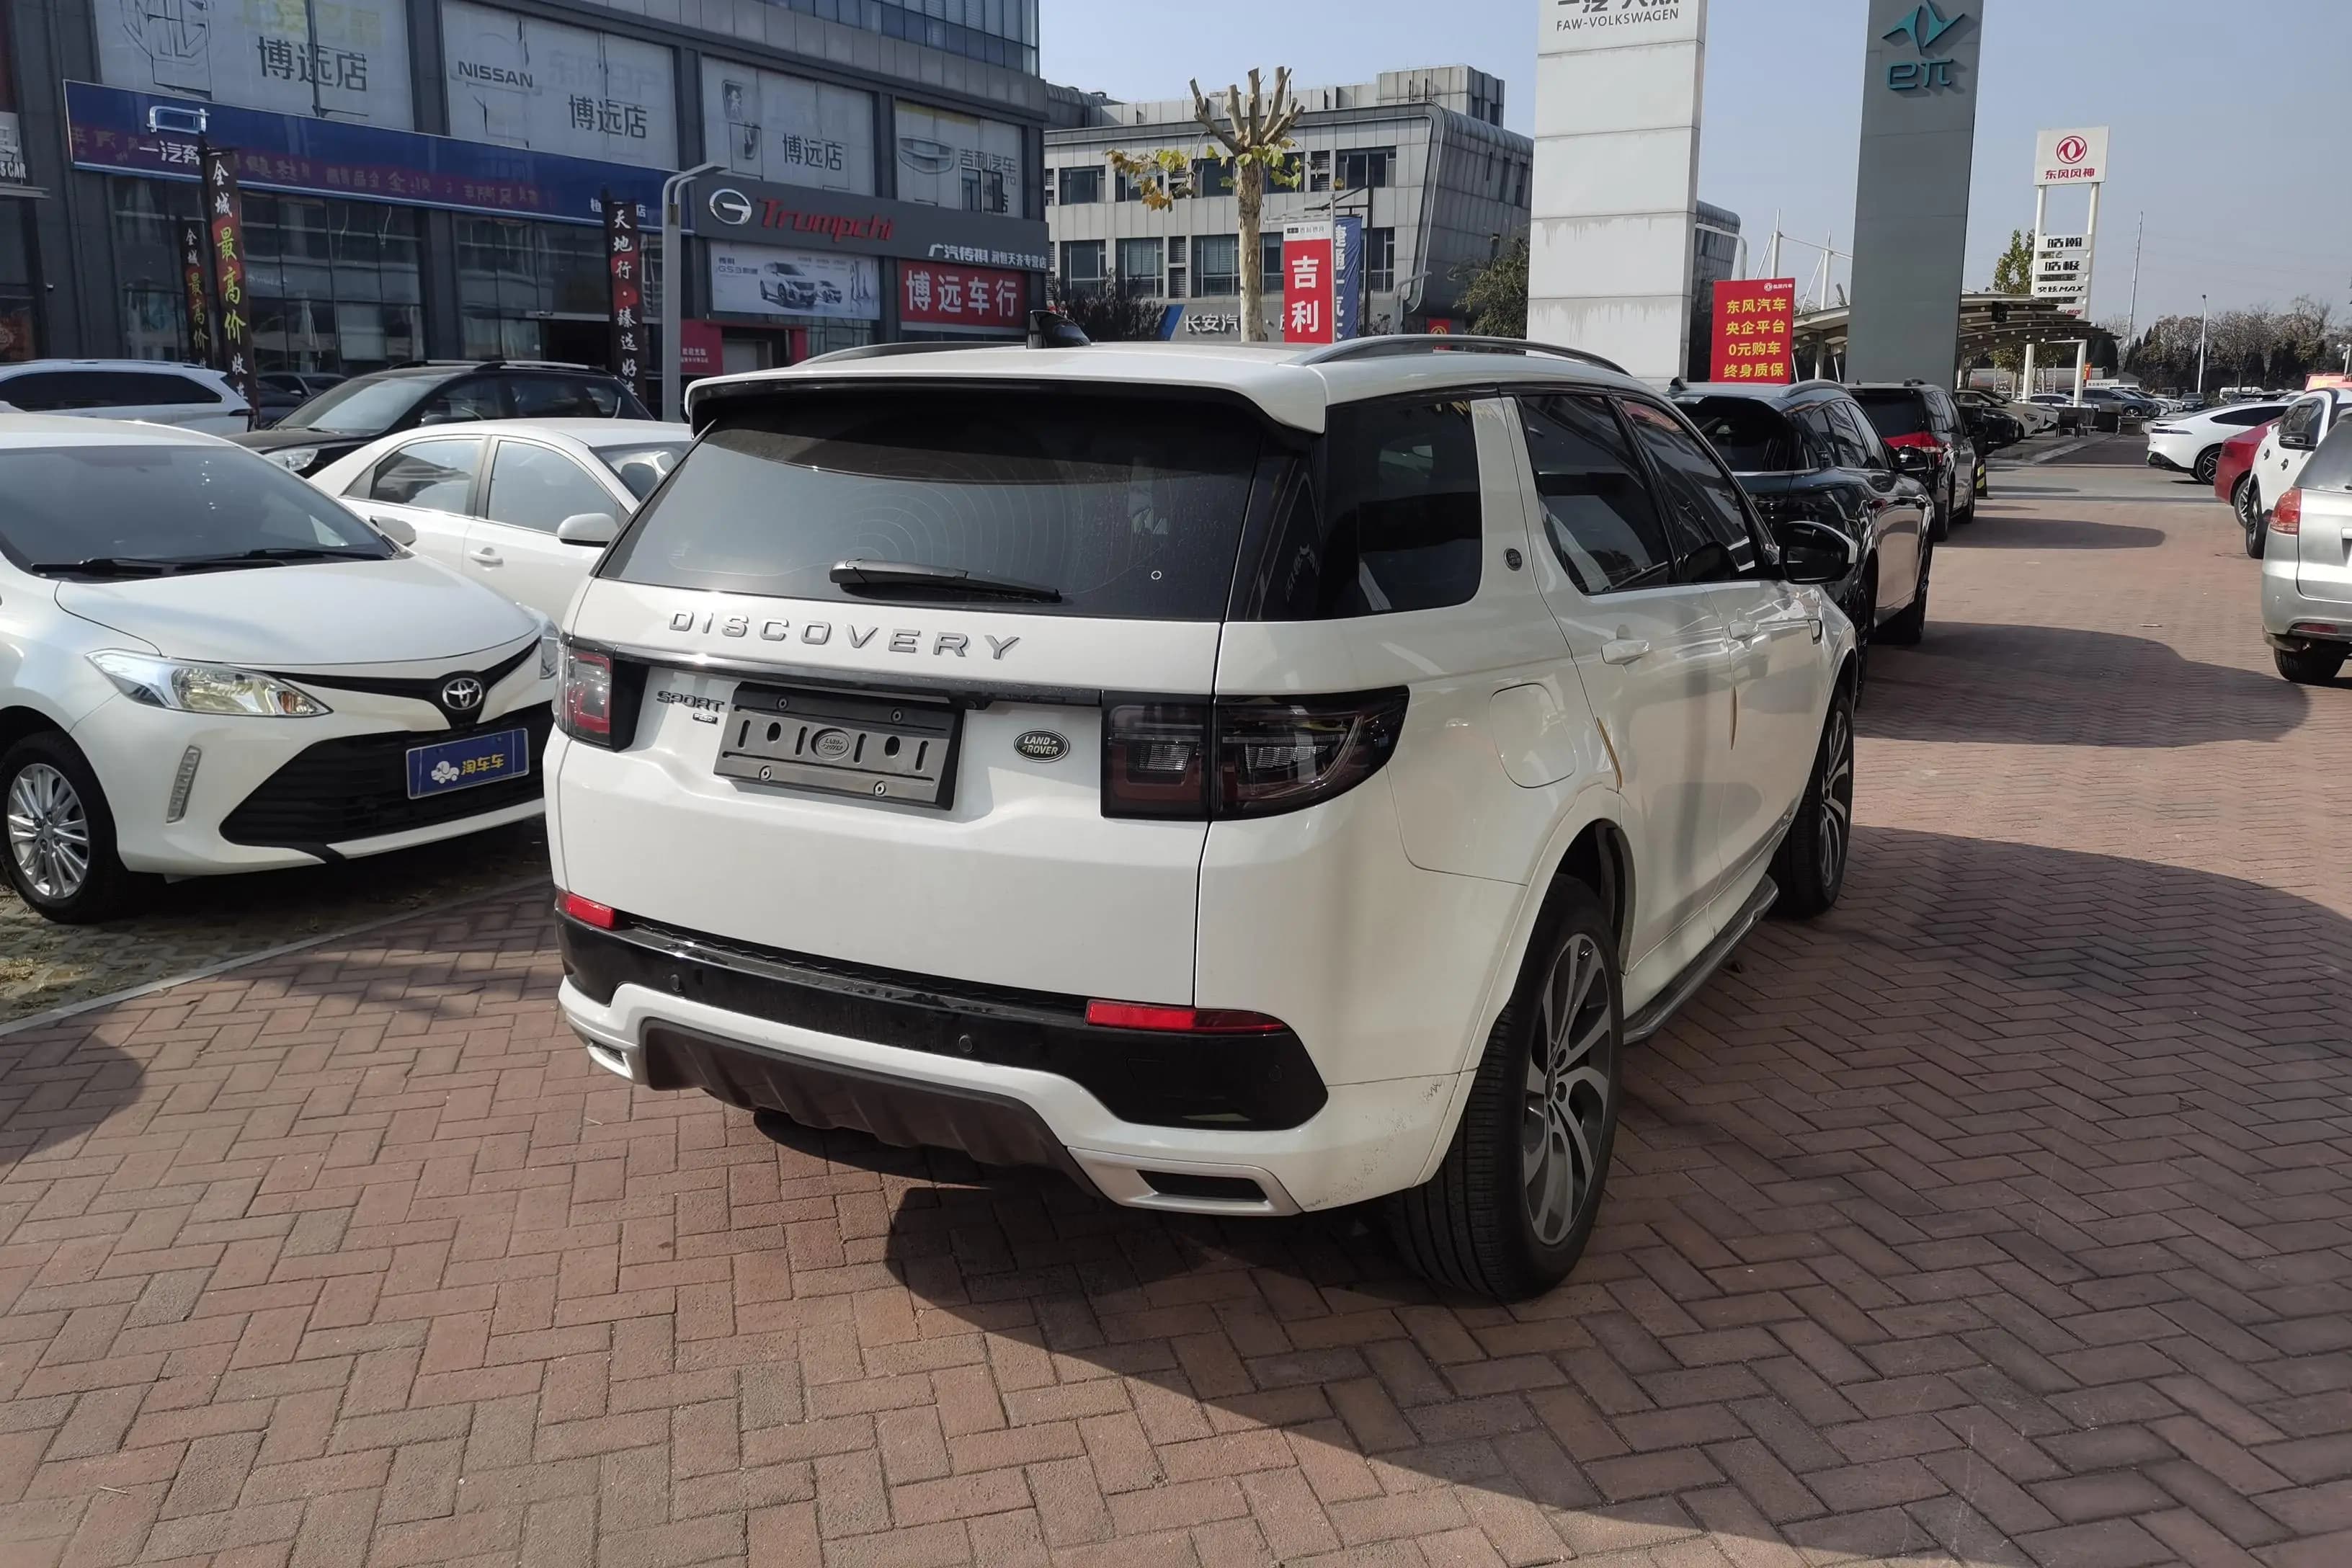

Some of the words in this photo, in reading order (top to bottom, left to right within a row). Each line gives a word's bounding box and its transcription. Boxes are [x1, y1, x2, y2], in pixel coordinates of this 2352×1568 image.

[1556, 8, 1679, 32] FAW-VOLKSWAGEN
[257, 36, 367, 92] 博远店
[458, 61, 533, 88] NISSAN
[569, 94, 647, 139] 博远店
[138, 139, 202, 166] 一汽奔
[783, 133, 842, 171] 博远店
[959, 148, 1017, 174] 吉利汽车
[7, 161, 27, 179] CAR
[2045, 168, 2095, 180] 东风风神
[757, 197, 895, 243] Trumpchi
[906, 268, 1017, 318] 博远车行
[1291, 254, 1319, 334] 吉利
[1727, 297, 1787, 314] 东风汽车
[1183, 313, 1242, 333] 长安汽
[1725, 319, 1786, 336] 央企平台
[1728, 341, 1781, 357] 0元购车
[1723, 362, 1784, 378] 终身质保
[669, 609, 1020, 660] DISCOVERY
[656, 690, 725, 713] SPORT
[1024, 736, 1051, 745] LAND
[1027, 744, 1059, 755] ROVER
[461, 753, 505, 775] 淘车车
